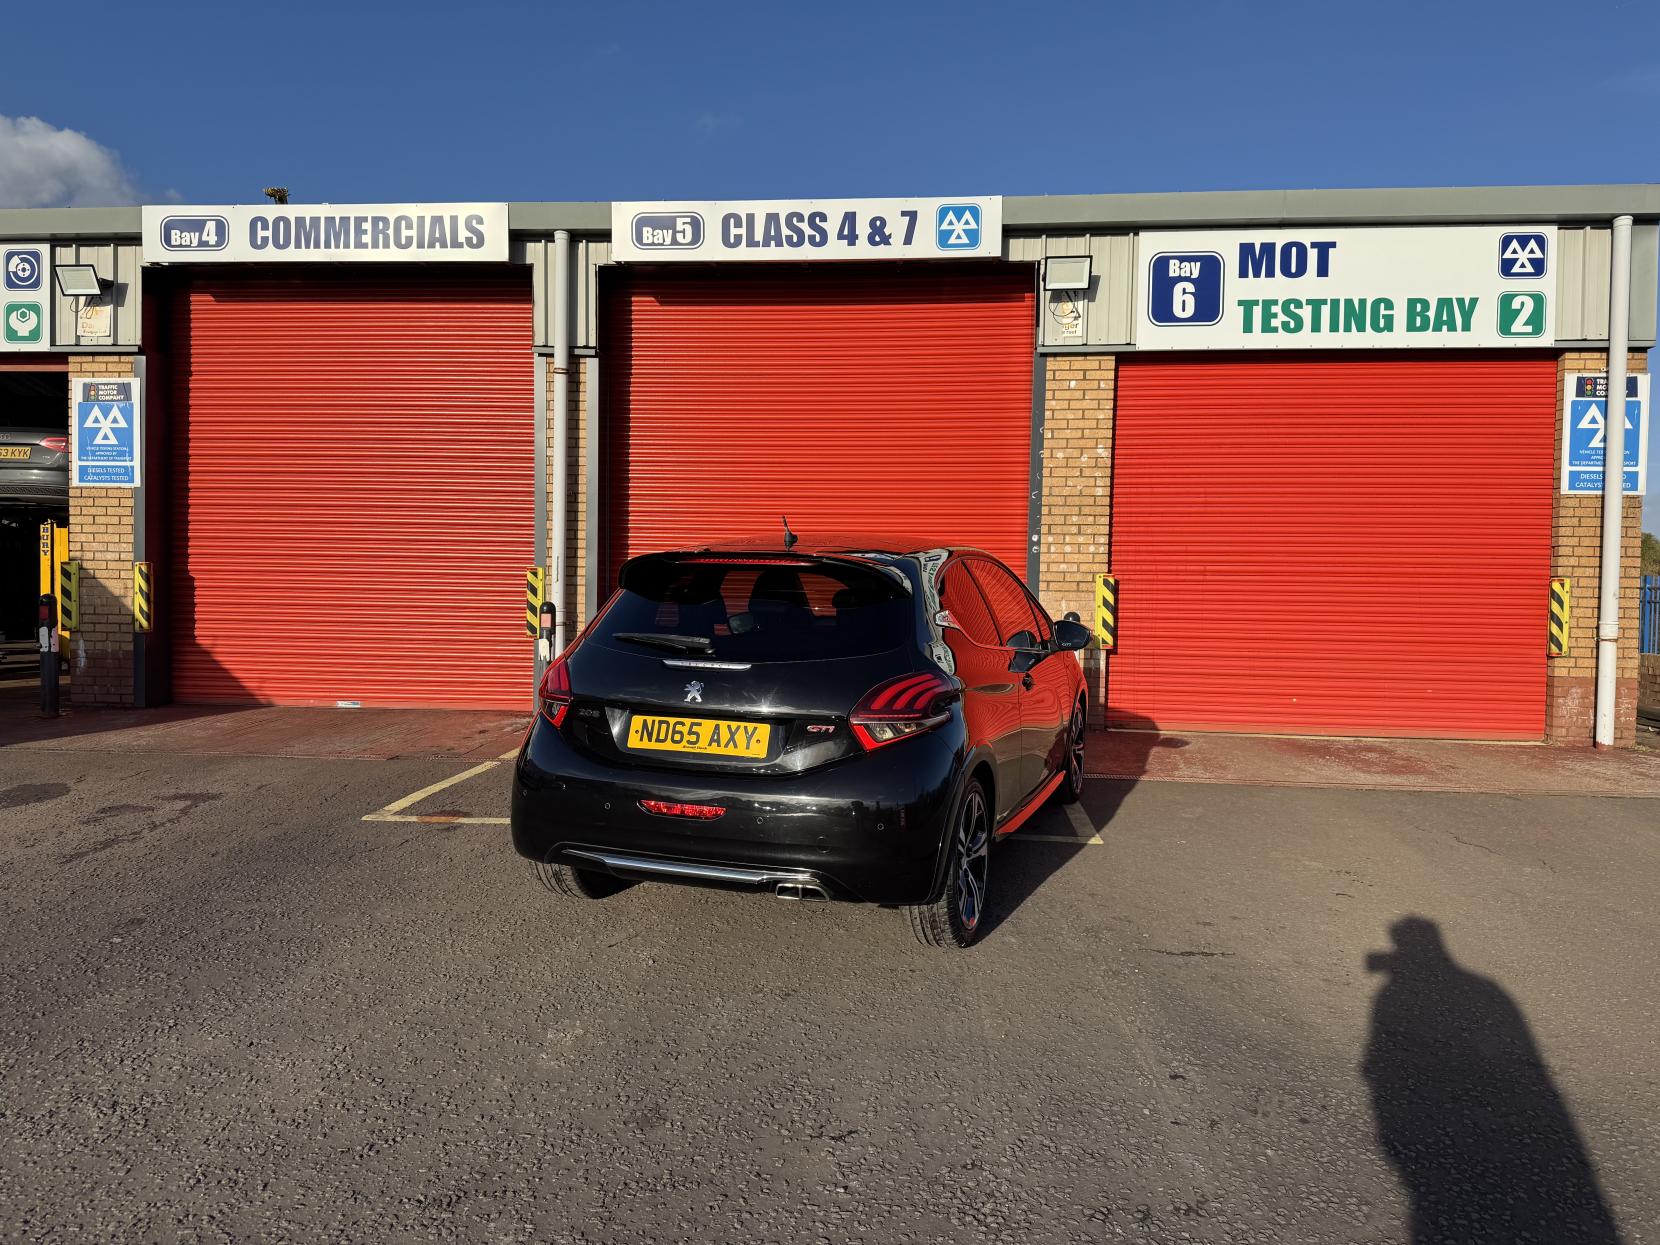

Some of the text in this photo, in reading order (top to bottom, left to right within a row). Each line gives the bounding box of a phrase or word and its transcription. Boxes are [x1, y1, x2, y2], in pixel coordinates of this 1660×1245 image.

[170, 220, 218, 247] Bay 4
[249, 214, 486, 250] COMMERCIALS
[642, 217, 693, 246] Bay 5
[721, 210, 919, 249] CLASS 4 & 7
[1168, 259, 1201, 279] Bay
[1238, 240, 1337, 279] MOT
[1172, 281, 1196, 319] 6
[1237, 296, 1480, 334] TESTING BAY
[1510, 295, 1535, 333] 2
[10, 448, 30, 457] KYK
[639, 718, 758, 750] ND65 AXY
